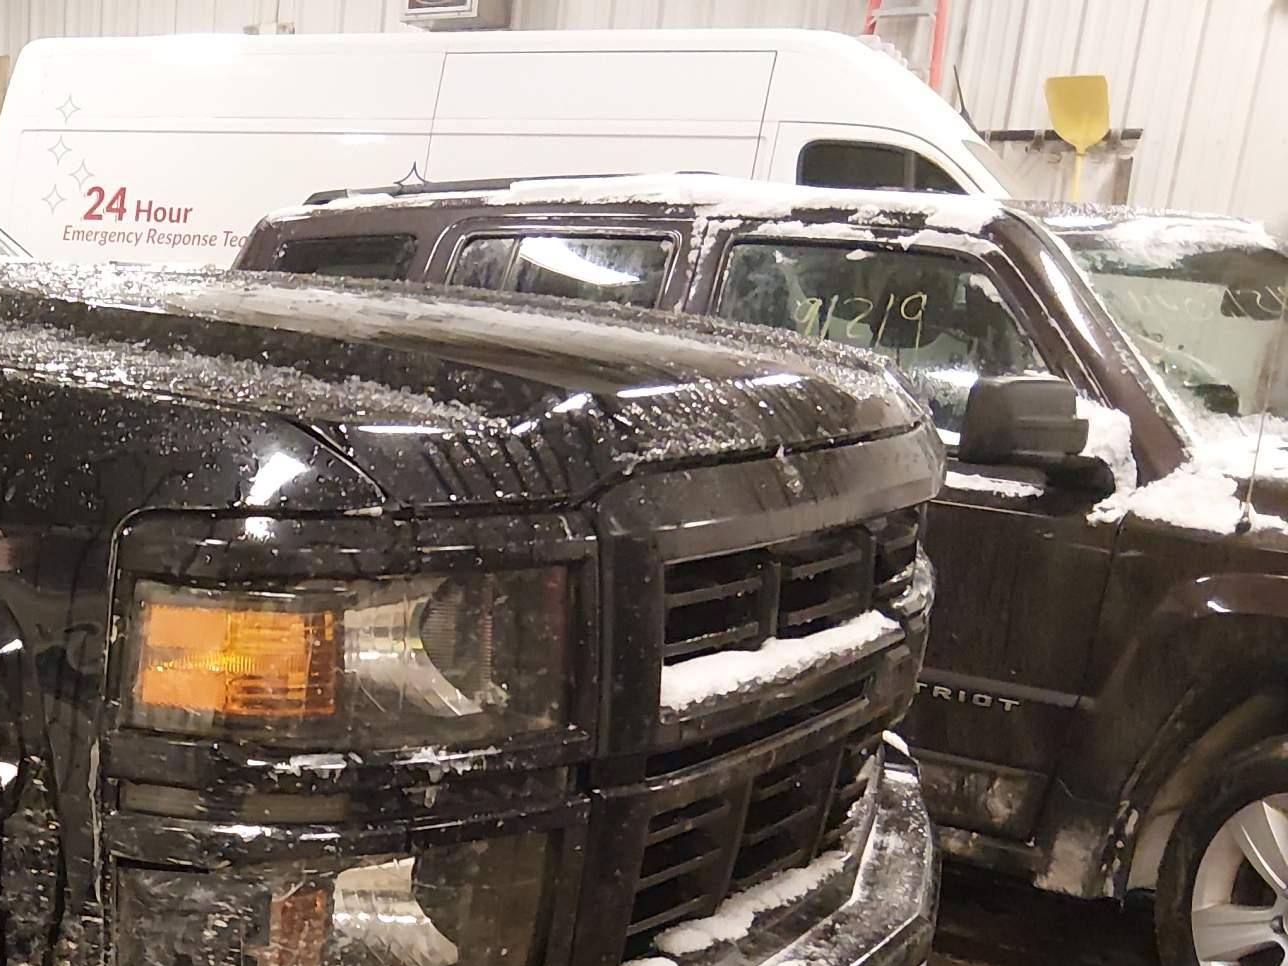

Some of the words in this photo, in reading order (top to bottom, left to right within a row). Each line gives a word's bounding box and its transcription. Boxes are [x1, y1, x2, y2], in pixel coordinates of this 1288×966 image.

[82, 186, 127, 222] 24
[134, 199, 193, 224] Hour
[62, 224, 143, 247] Emergency
[146, 228, 218, 248] Response
